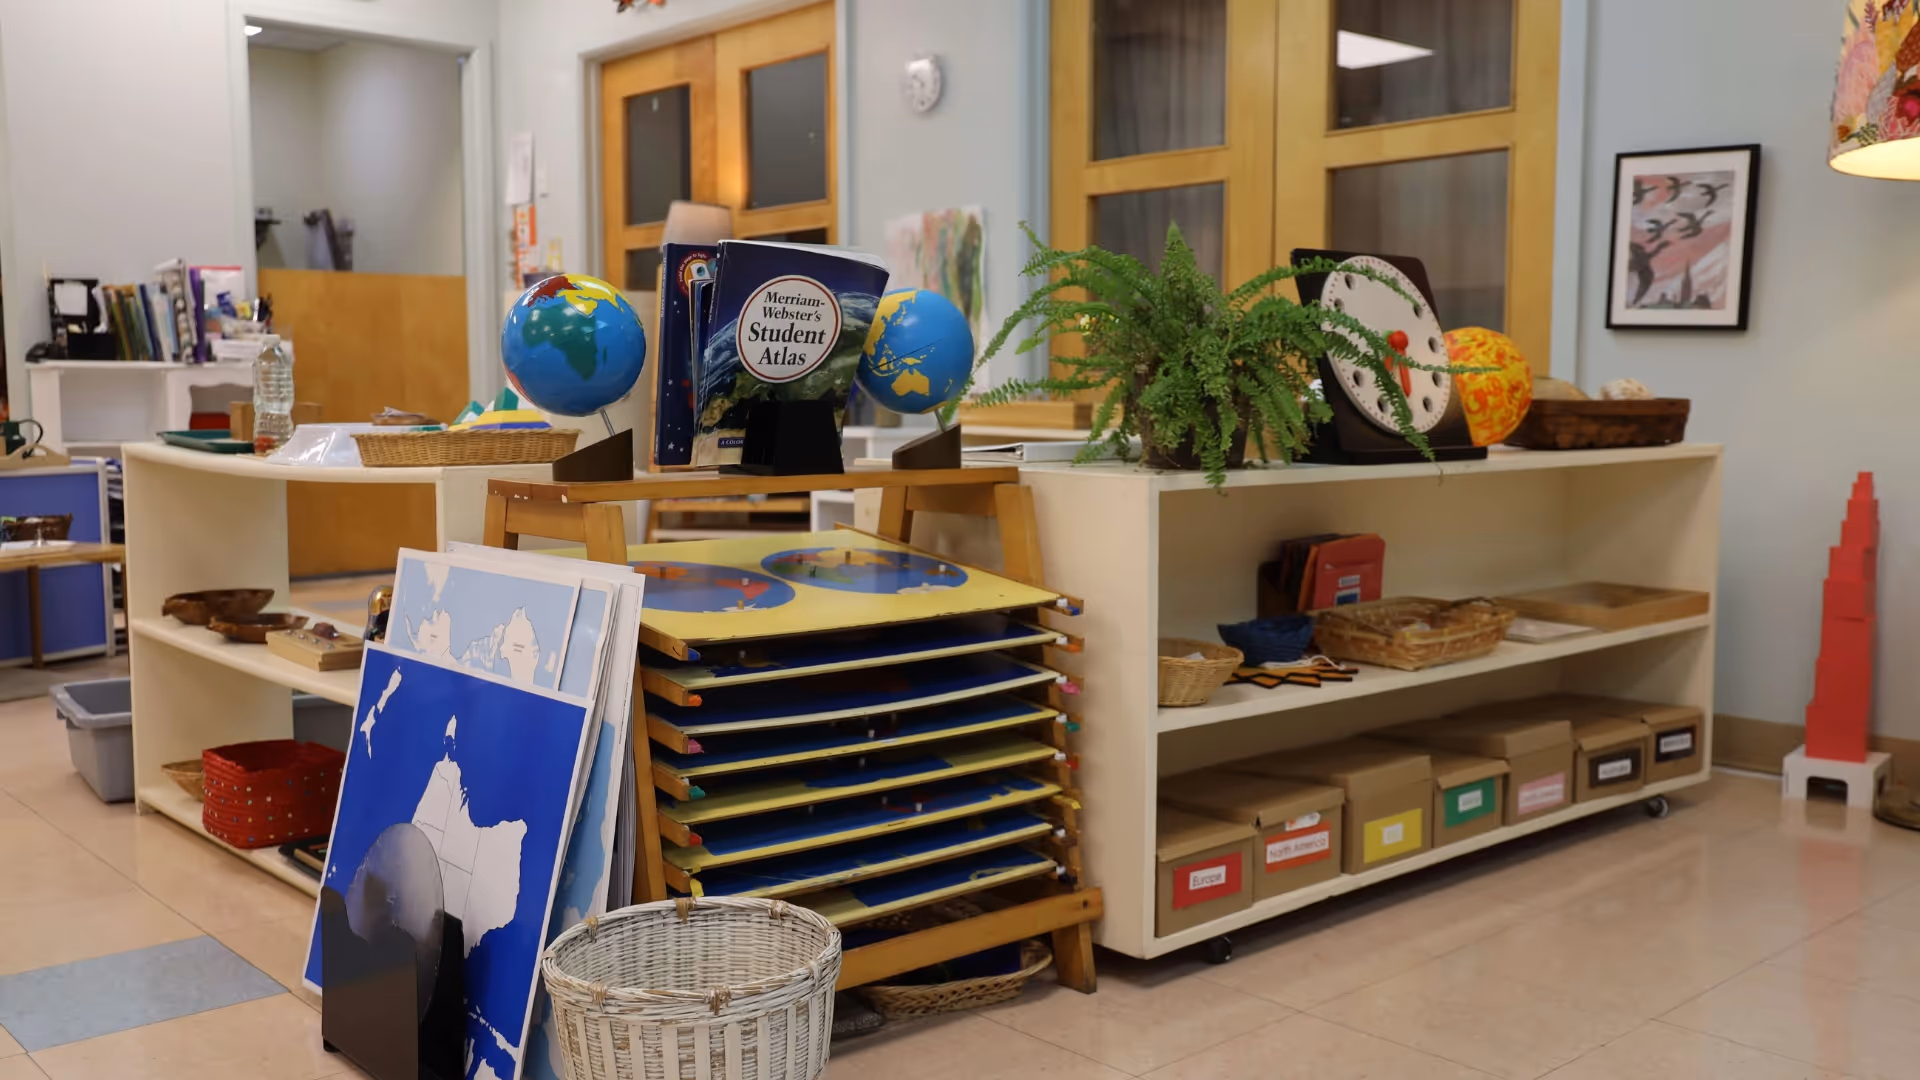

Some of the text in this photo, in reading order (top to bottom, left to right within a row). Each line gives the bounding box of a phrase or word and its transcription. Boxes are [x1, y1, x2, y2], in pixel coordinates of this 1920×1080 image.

[764, 291, 825, 307] Merriam-
[763, 306, 822, 322] Webster's
[748, 321, 826, 345] Student
[757, 346, 807, 366] Atlas
[1192, 872, 1222, 888] Europe
